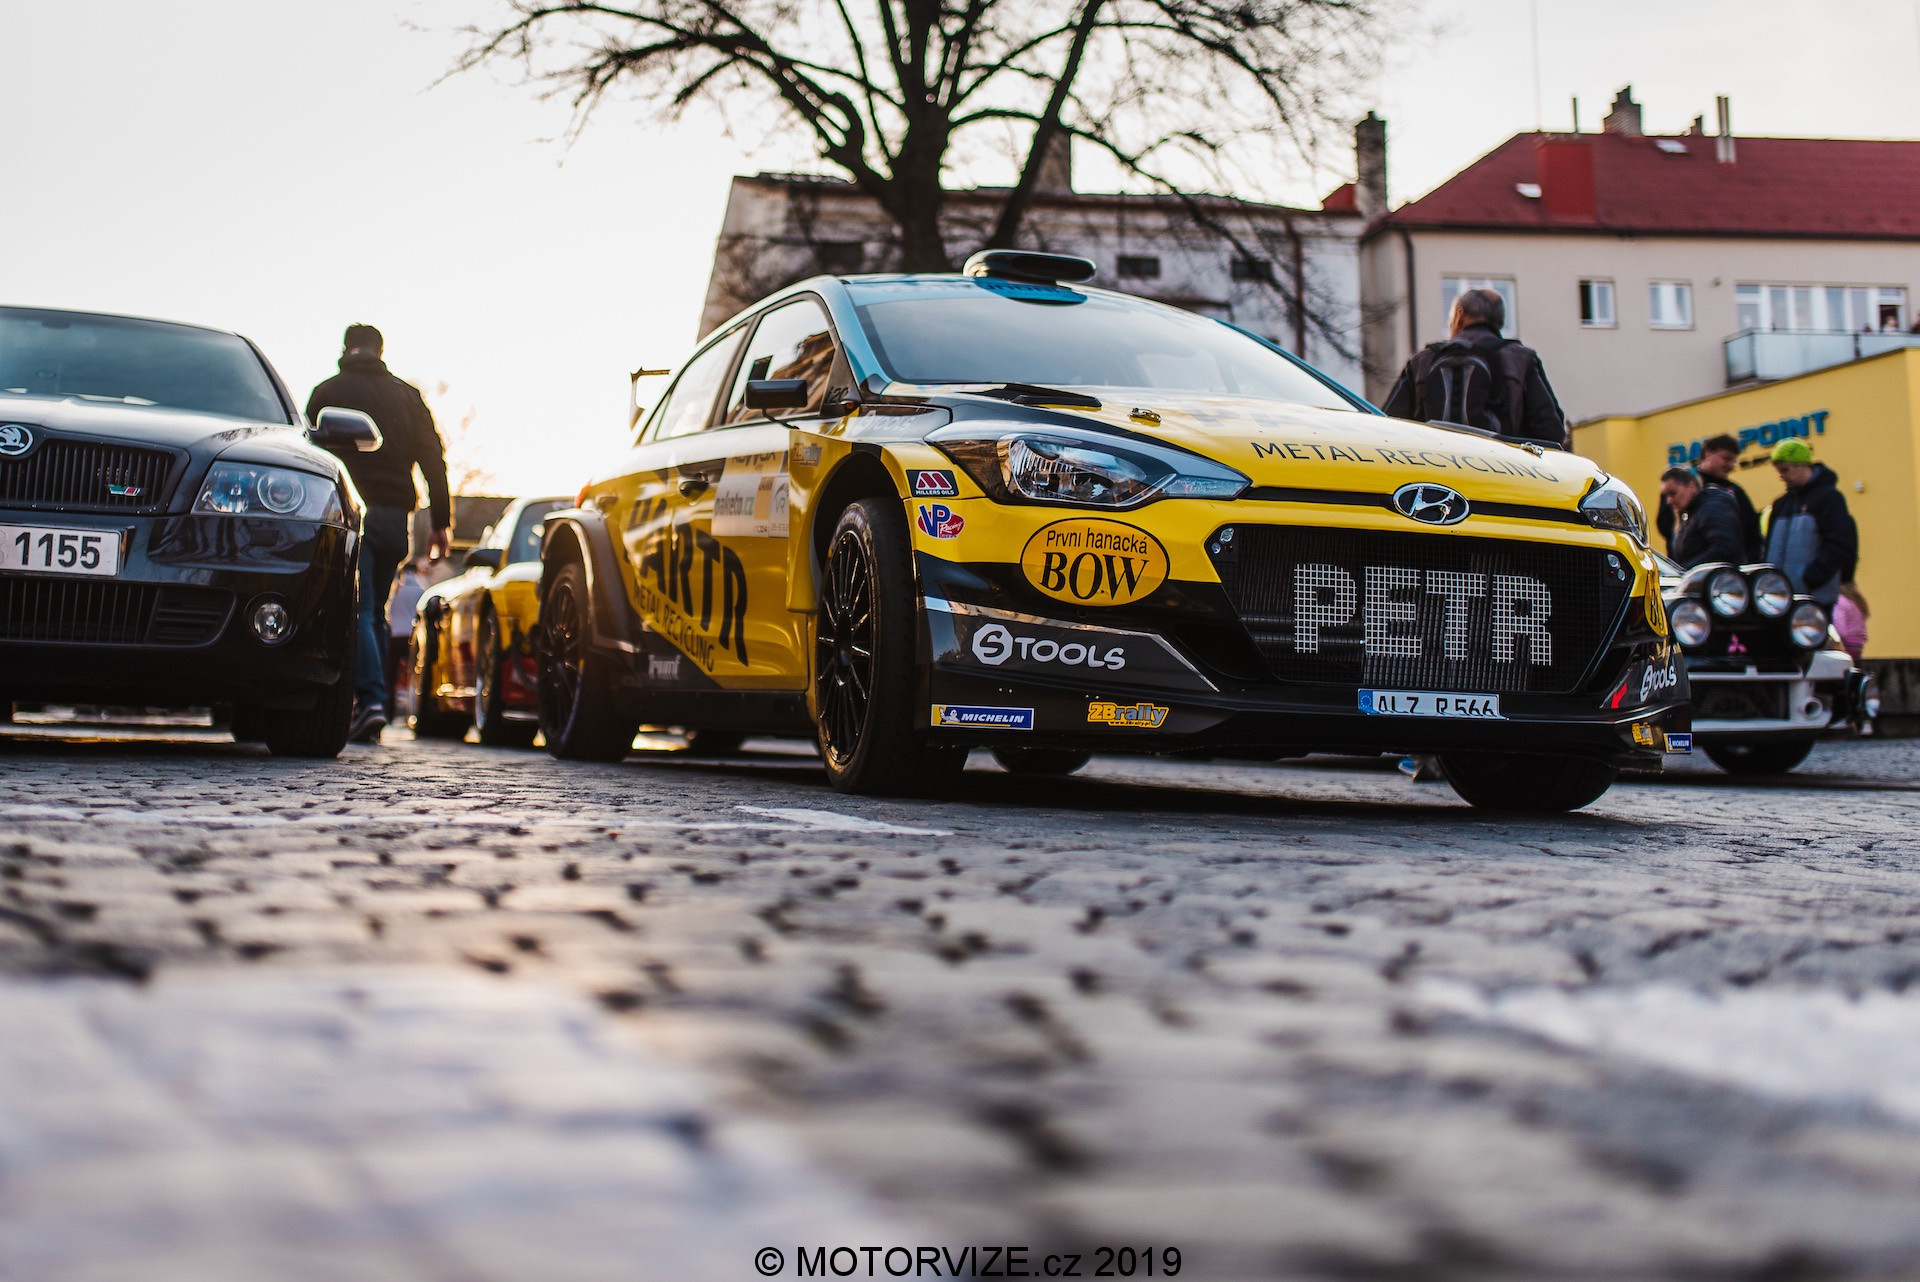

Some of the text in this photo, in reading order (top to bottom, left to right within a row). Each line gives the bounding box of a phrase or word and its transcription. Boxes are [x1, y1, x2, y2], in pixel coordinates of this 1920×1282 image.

[1738, 409, 1829, 450] POINT
[1250, 441, 1560, 483] METAL RECYCLING
[918, 503, 951, 538] VP
[15, 531, 102, 569] 1155
[1294, 563, 1552, 667] PETR
[661, 602, 715, 674] RECYCLING
[961, 713, 1025, 723] MICHELIN
[1089, 703, 1167, 726] 2Brally
